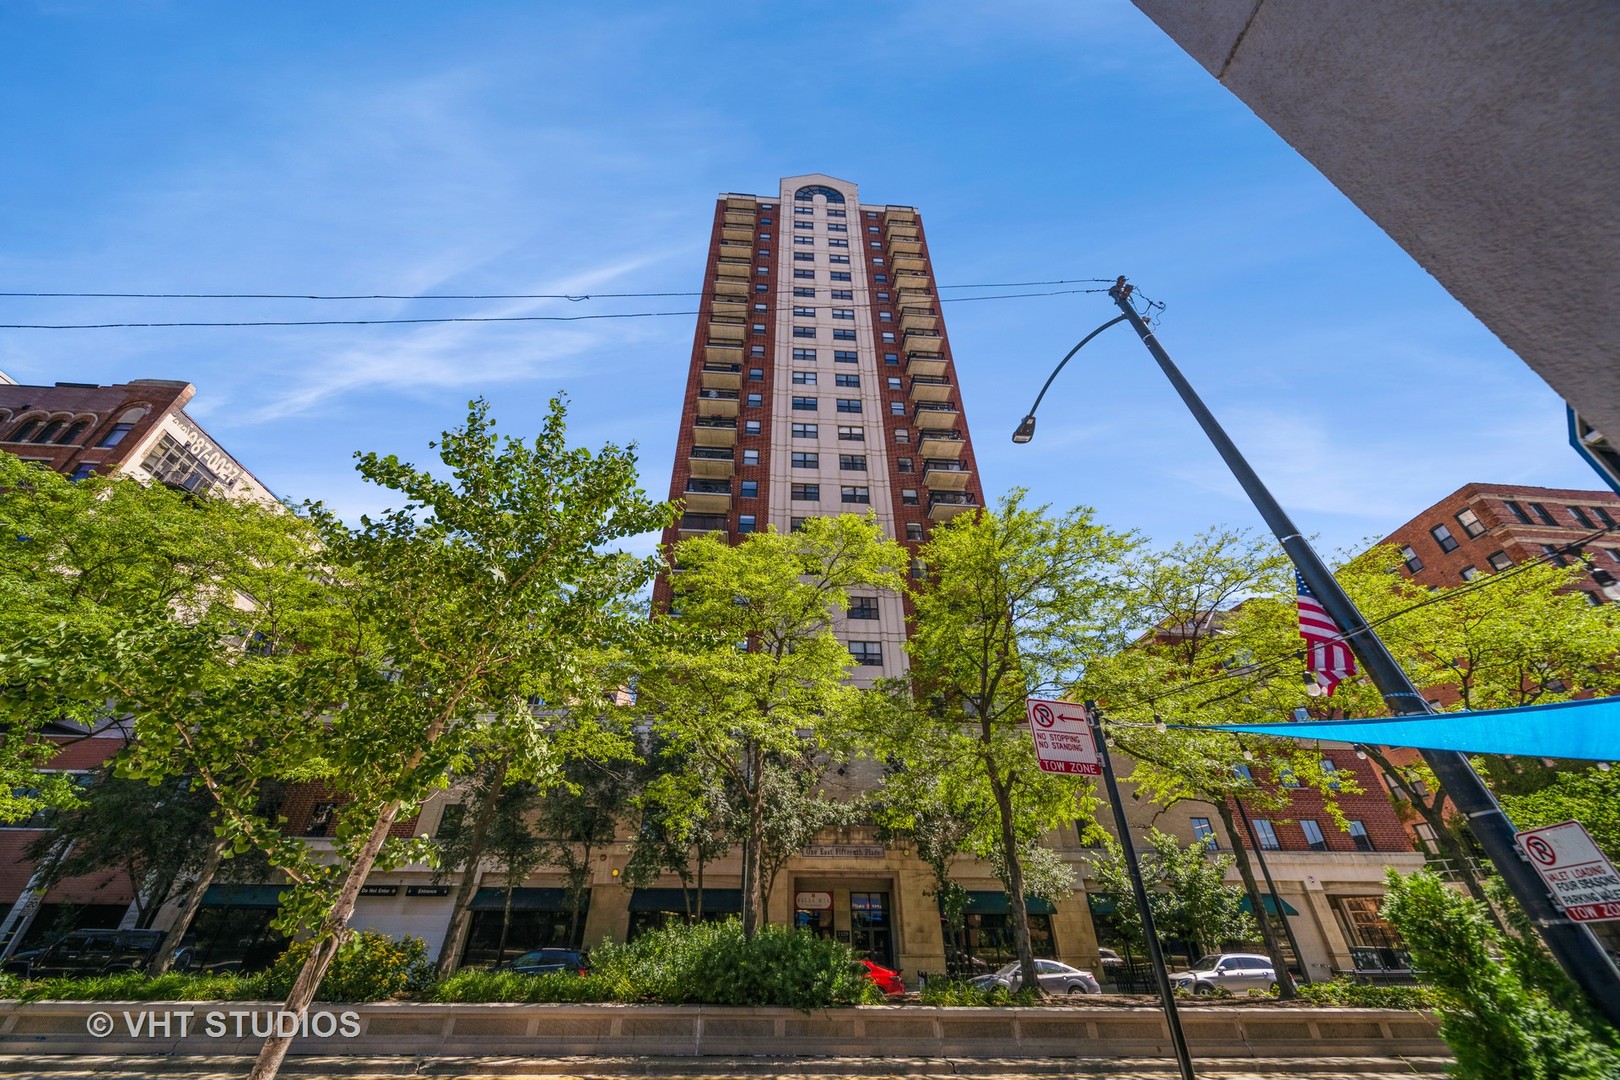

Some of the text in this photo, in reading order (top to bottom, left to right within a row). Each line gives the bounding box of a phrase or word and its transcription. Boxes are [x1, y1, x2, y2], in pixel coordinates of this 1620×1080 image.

[1037, 733, 1080, 744] NO STOPPING
[1039, 741, 1082, 752] NO STANDING
[1043, 760, 1097, 774] TOW ZONE
[1546, 866, 1606, 882] VALET LOADING
[1556, 875, 1620, 892] FOUR SEASONS
[1562, 892, 1600, 906] PARKING
[1568, 906, 1600, 920] TOW
